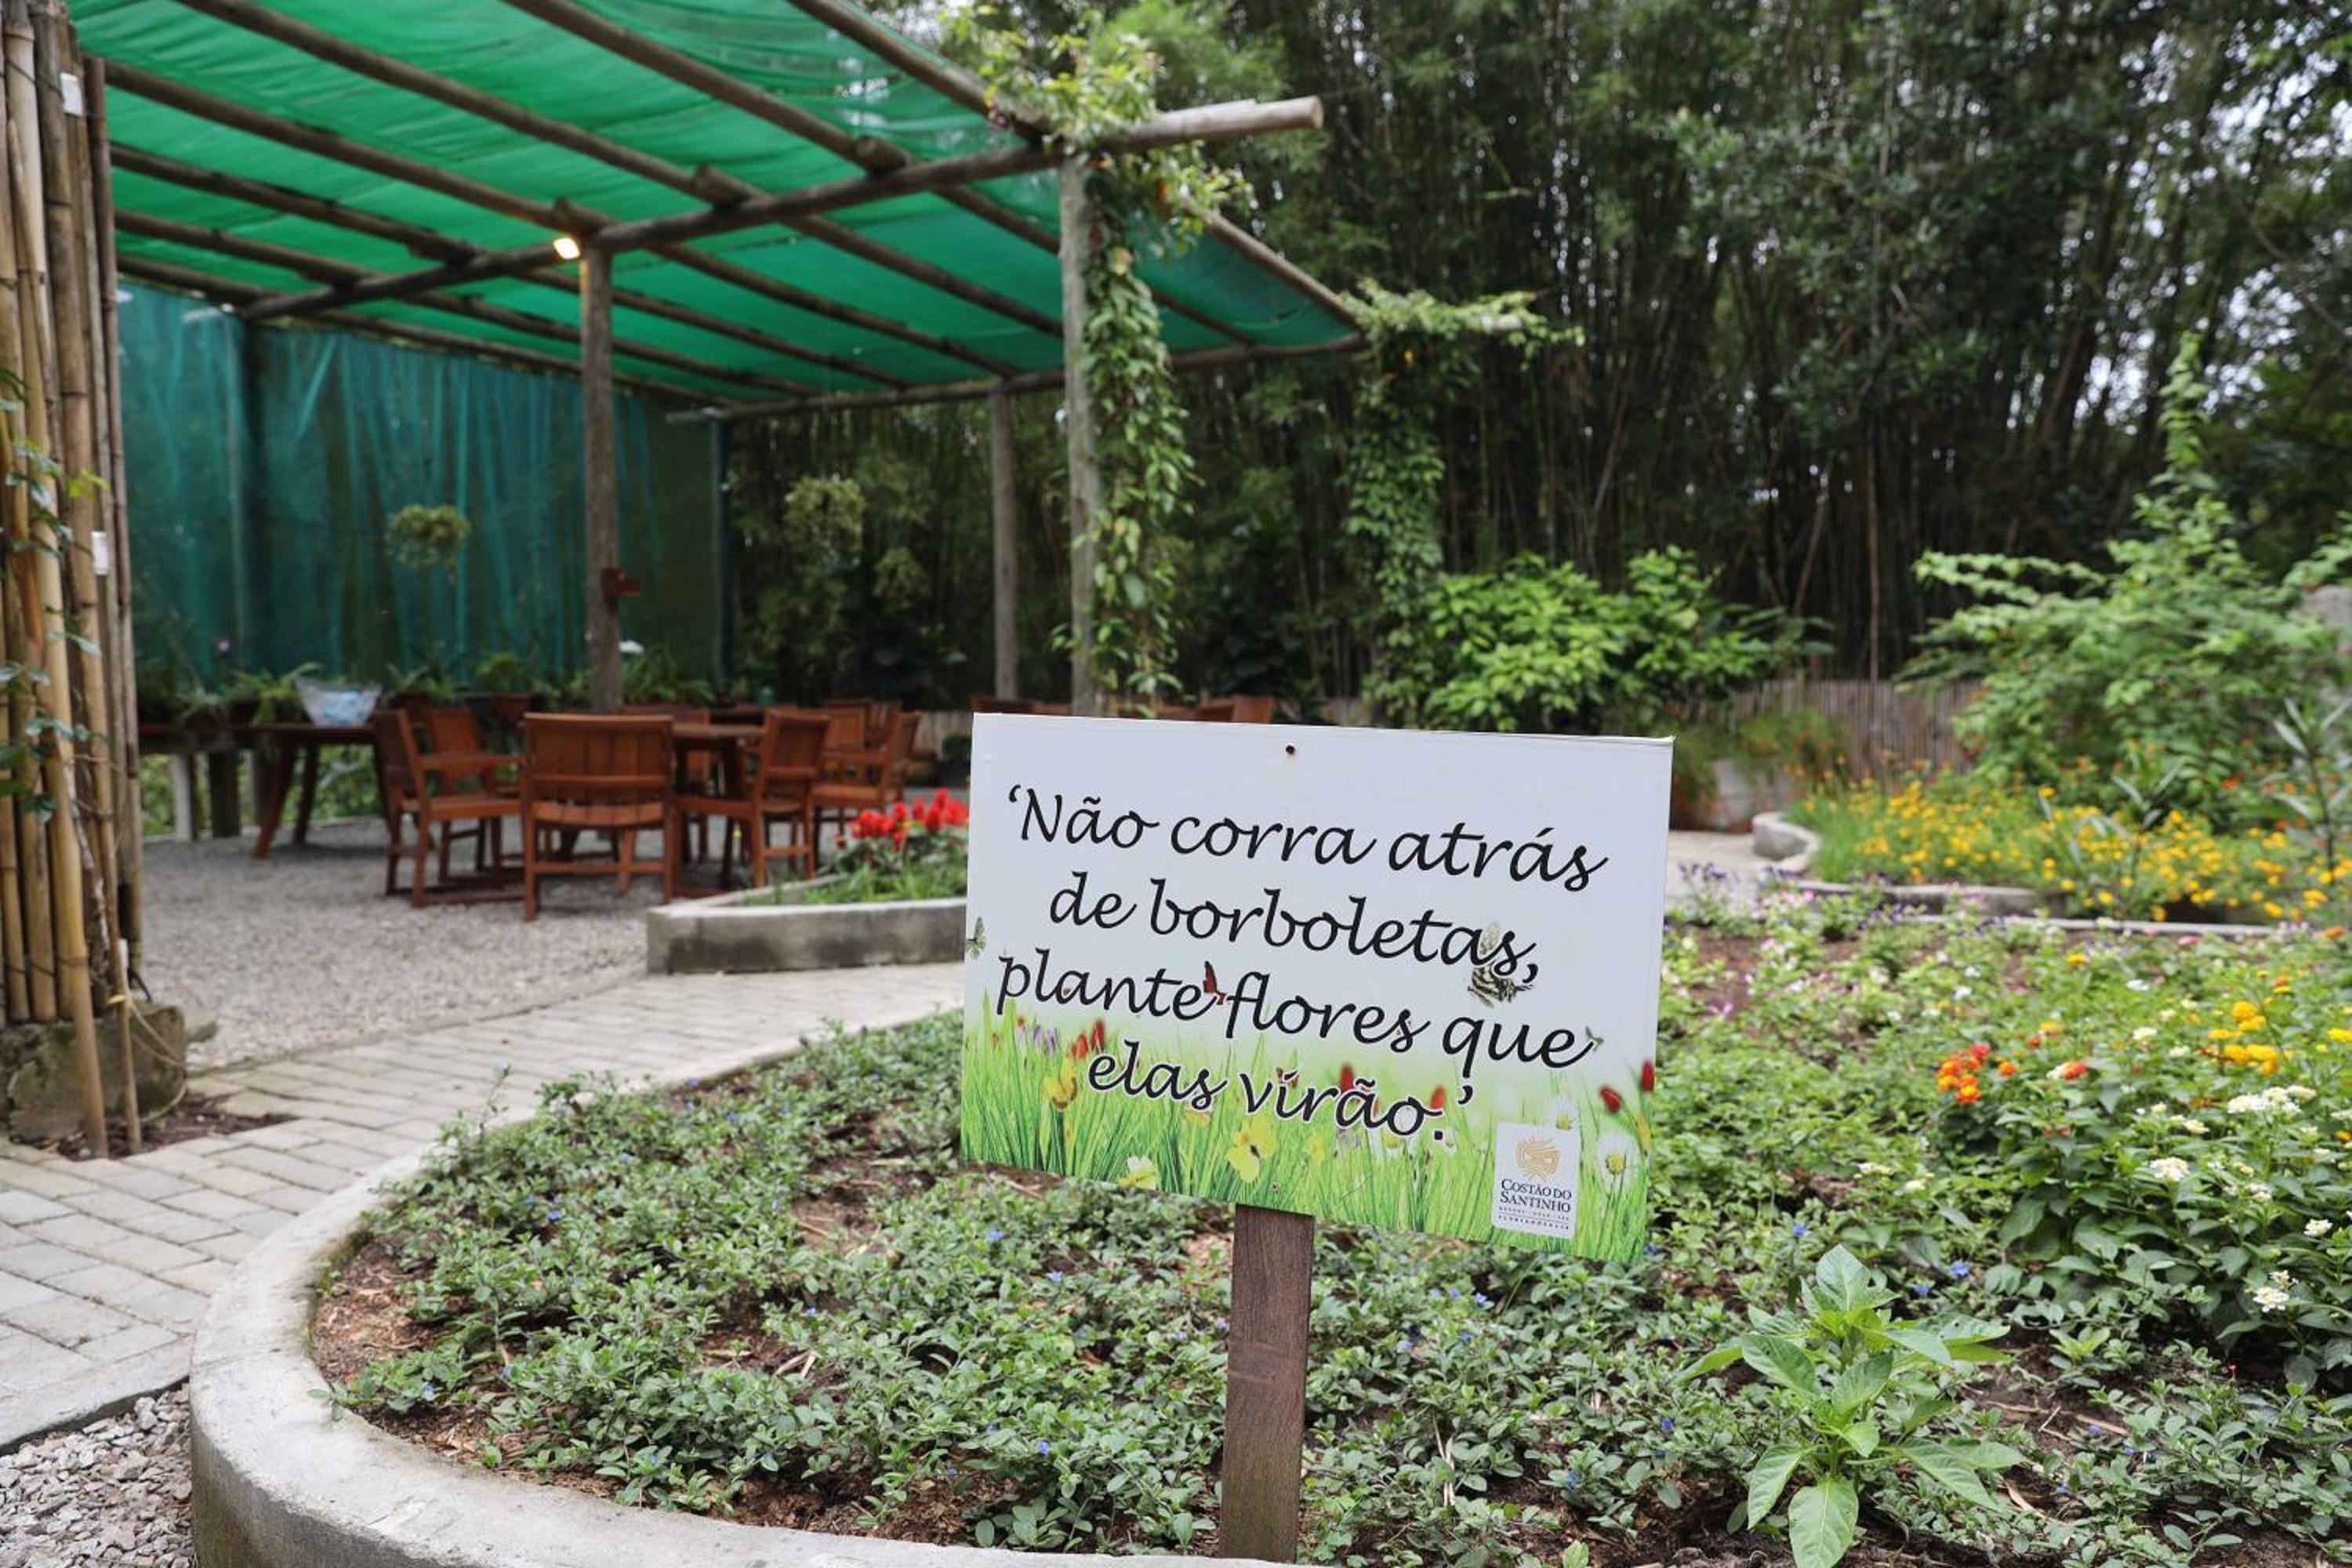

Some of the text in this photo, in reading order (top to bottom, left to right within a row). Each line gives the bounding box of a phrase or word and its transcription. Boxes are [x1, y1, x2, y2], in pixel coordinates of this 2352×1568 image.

[1171, 817, 1377, 866] corra
[1388, 822, 1609, 892] atrás
[1050, 870, 1537, 984] de borboletas,
[997, 947, 1595, 1079] plante flores que
[1088, 1039, 1228, 1110] elas
[1500, 1190, 1571, 1213] SANTINHO
[1553, 1188, 1572, 1200] DO
